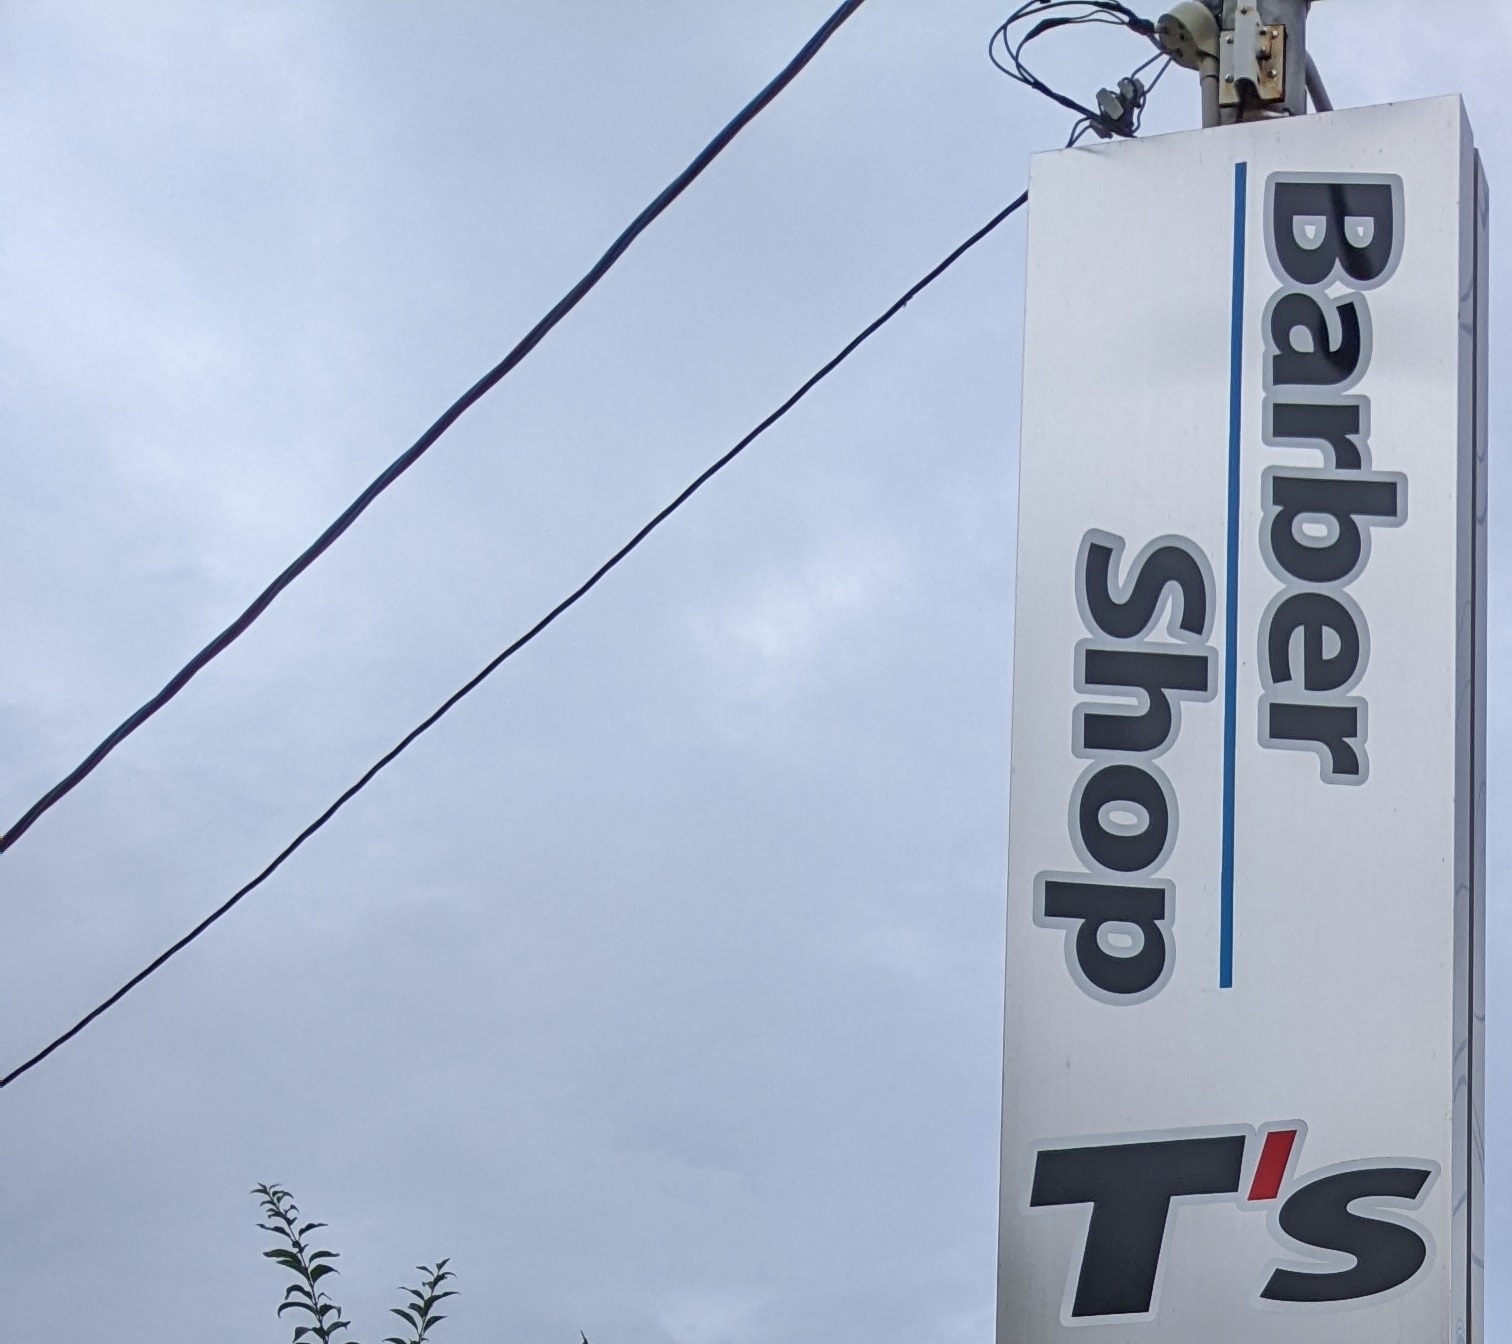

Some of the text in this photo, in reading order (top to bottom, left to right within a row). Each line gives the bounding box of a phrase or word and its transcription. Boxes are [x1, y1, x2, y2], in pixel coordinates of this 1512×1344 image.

[1269, 181, 1398, 777] Barber
[1043, 541, 1210, 996] Shop
[1029, 1129, 1433, 1318] T's
